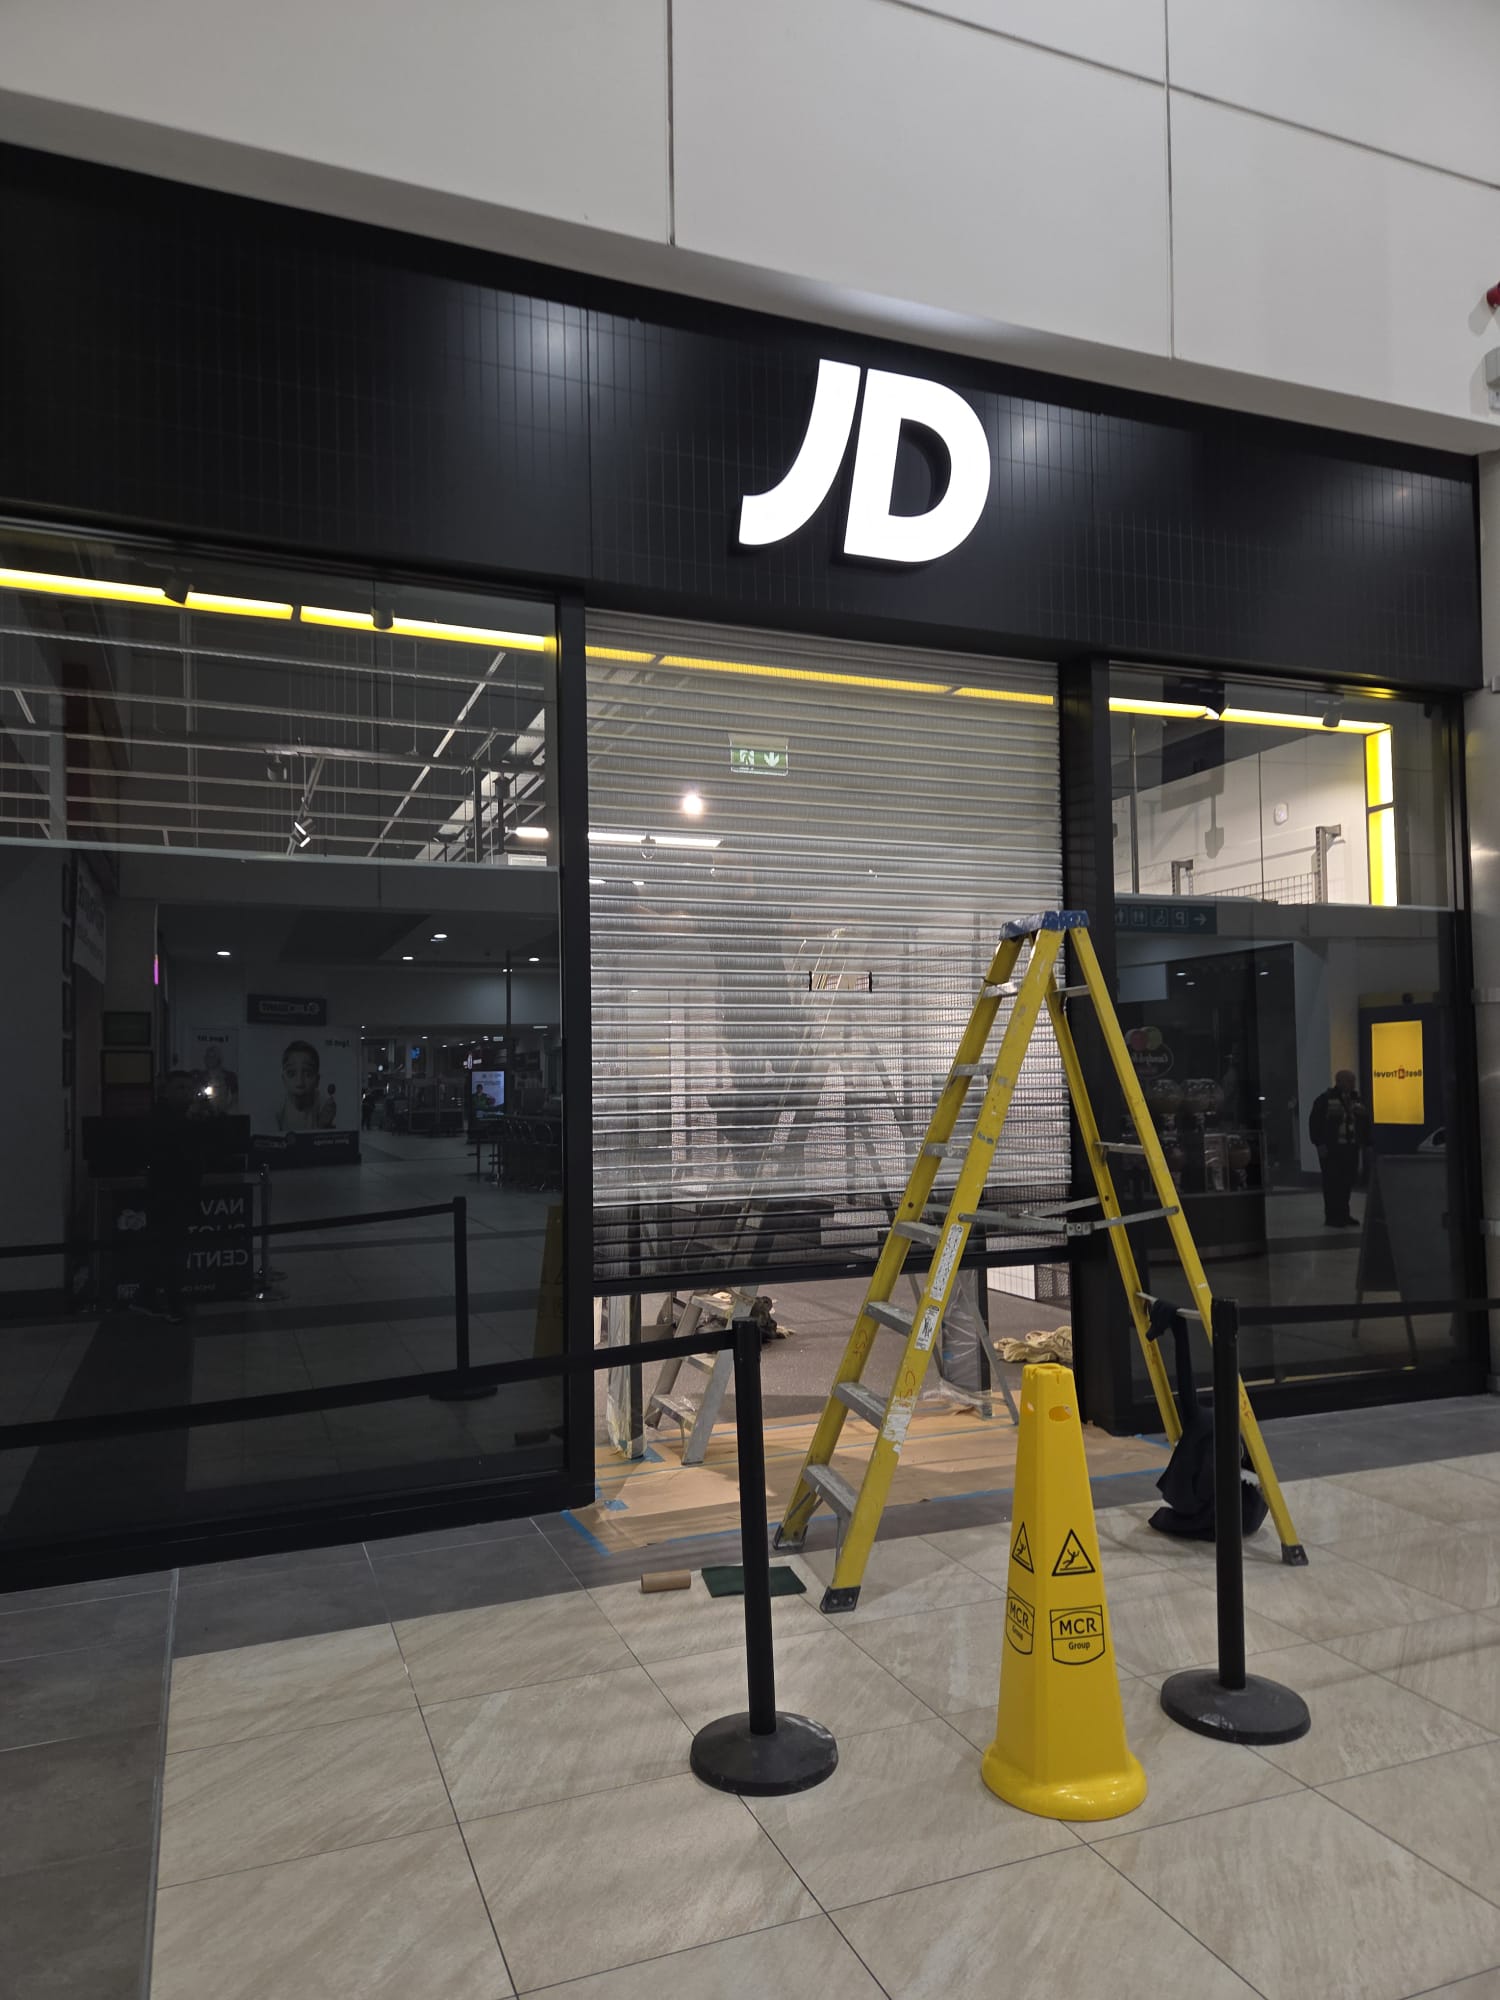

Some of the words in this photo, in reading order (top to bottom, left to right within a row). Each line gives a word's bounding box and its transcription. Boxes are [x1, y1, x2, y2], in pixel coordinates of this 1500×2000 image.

[738, 358, 991, 564] JD
[1010, 1601, 1030, 1631] MCR
[1059, 1617, 1097, 1636] MCR
[1068, 1641, 1091, 1651] Group
